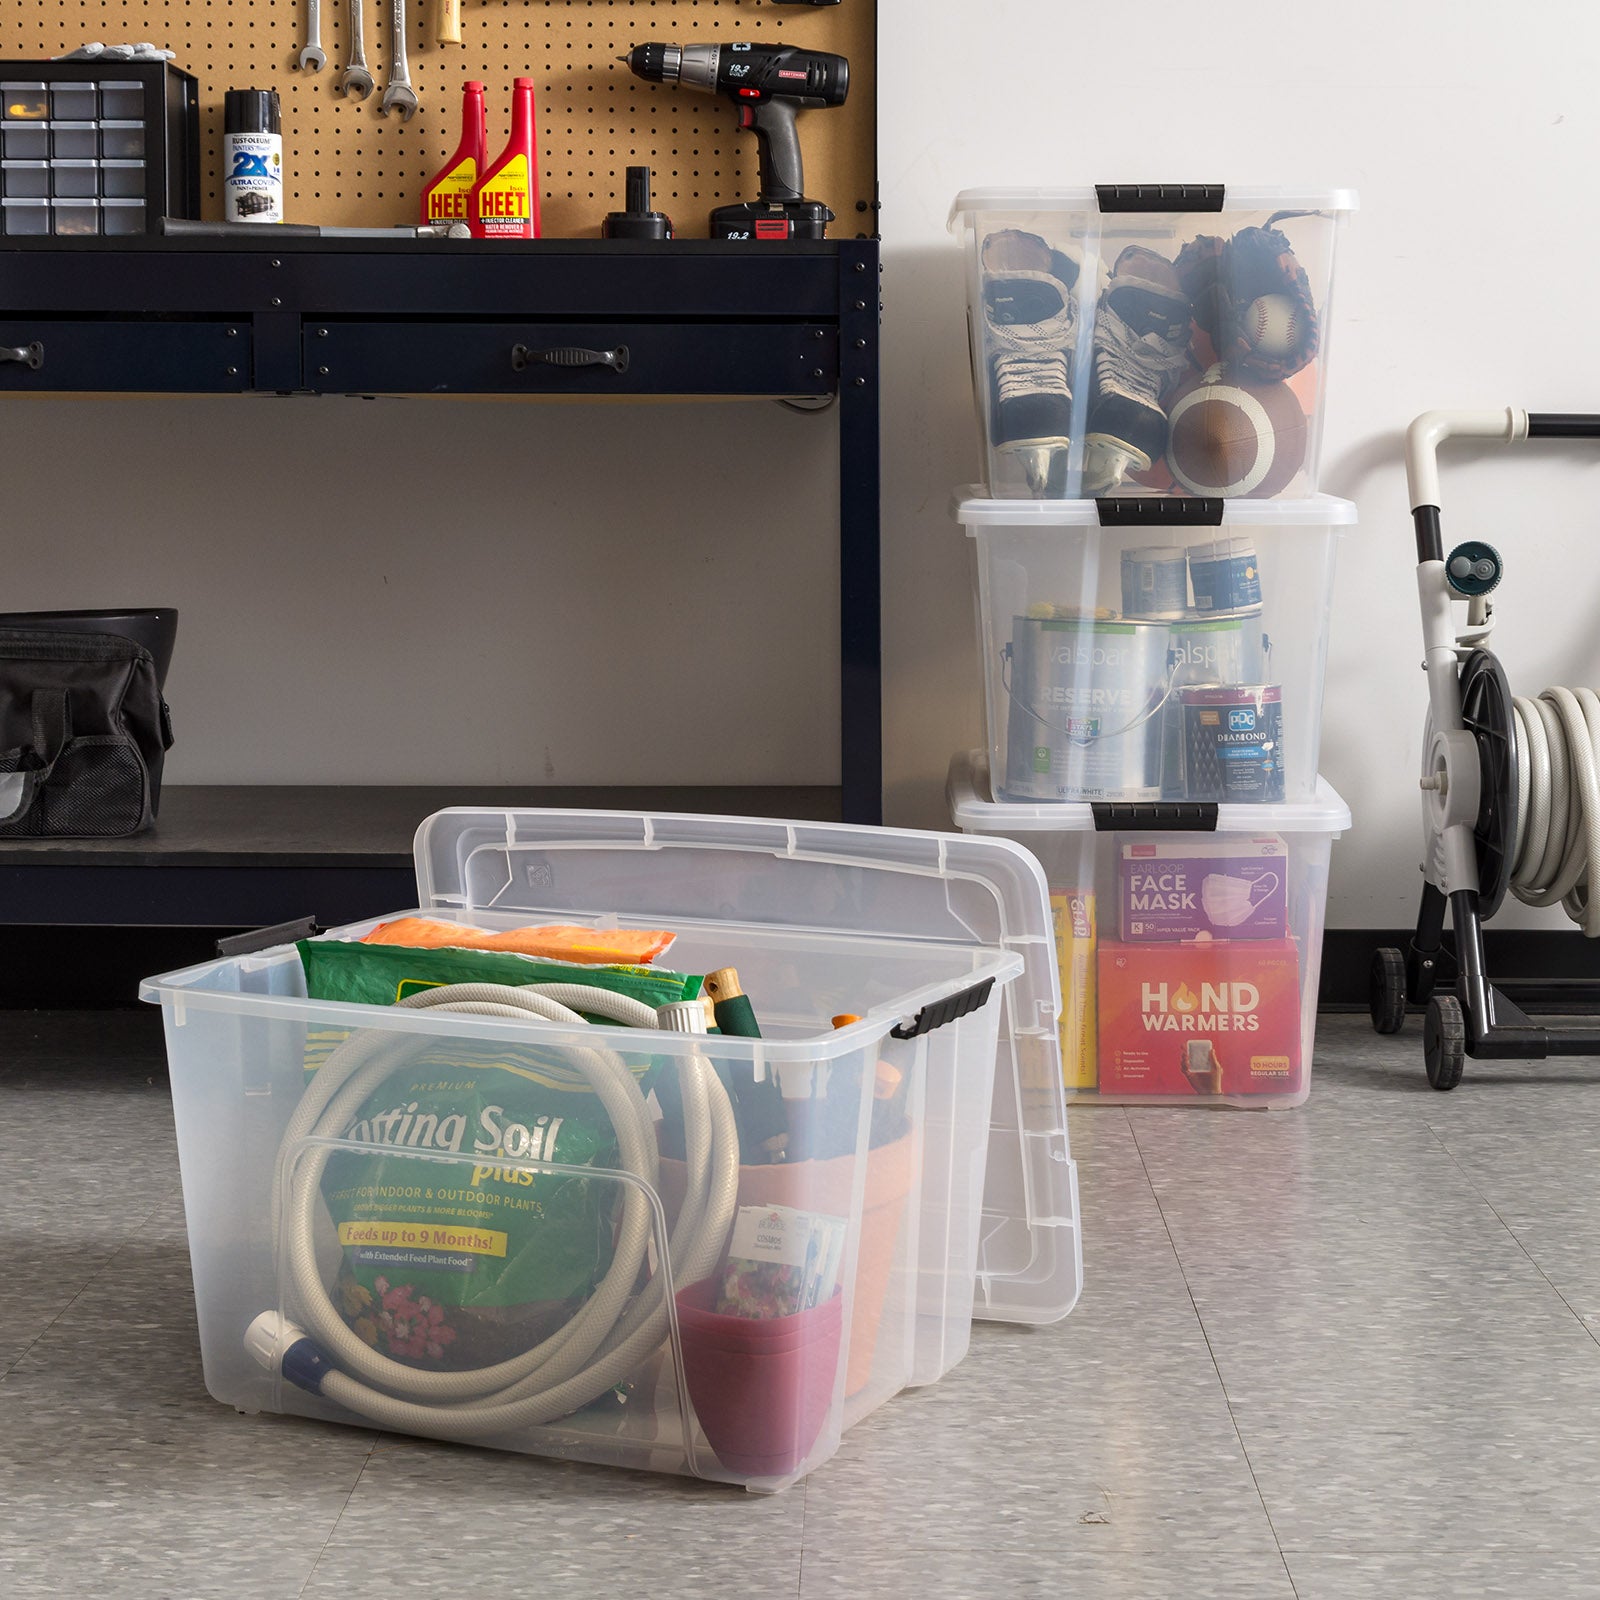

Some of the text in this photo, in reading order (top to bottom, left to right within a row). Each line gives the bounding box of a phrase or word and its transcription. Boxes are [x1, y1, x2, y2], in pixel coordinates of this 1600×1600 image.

[729, 64, 751, 73] 19.2
[233, 151, 268, 177] 2X
[482, 192, 525, 216] HEET
[727, 231, 750, 240] 19.2
[1048, 639, 1129, 670] valspar
[1040, 686, 1132, 705] RESERVE
[1217, 732, 1267, 742] DIAMOND
[1082, 788, 1103, 796] WHITE
[1130, 863, 1185, 874] EARLOOP
[1130, 874, 1187, 892] FACE
[1130, 892, 1197, 911] MASK
[1141, 1014, 1260, 1031] WARMERS
[410, 1080, 477, 1092] PREMIUM
[347, 1102, 564, 1168] otting Soil
[471, 1149, 535, 1187] plus
[375, 1186, 422, 1198] INDOOR
[425, 1188, 433, 1199] &
[437, 1188, 500, 1206] OUTDOOR
[503, 1196, 543, 1213] PLANTS
[398, 1204, 426, 1213] PLANTS
[433, 1205, 456, 1216] MORE
[346, 1227, 493, 1250] Feeds up to 9 Months!
[359, 1251, 374, 1260] with
[374, 1252, 408, 1263] Extended
[408, 1253, 427, 1264] Feed
[427, 1254, 448, 1265] Plant
